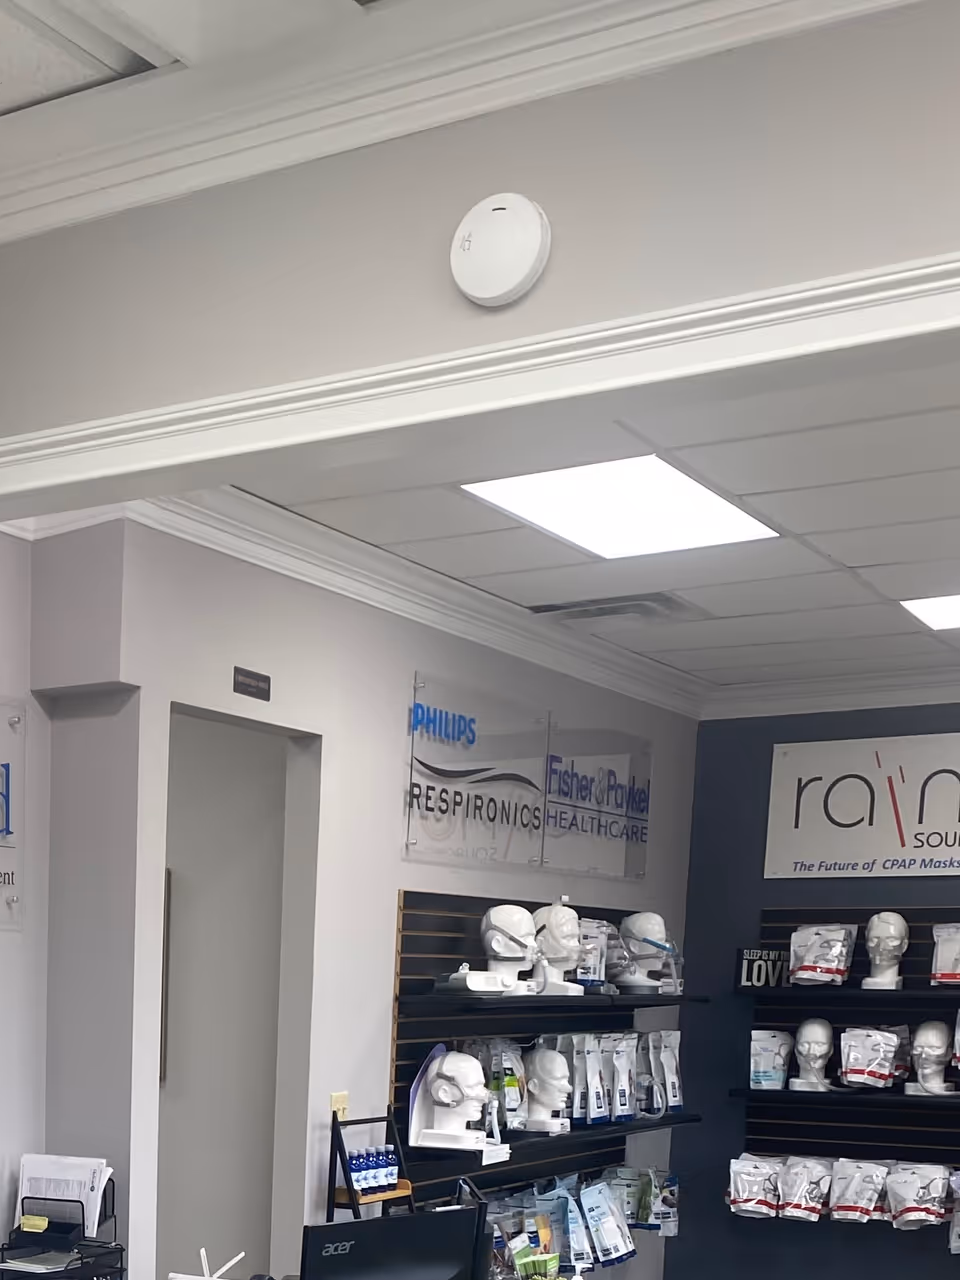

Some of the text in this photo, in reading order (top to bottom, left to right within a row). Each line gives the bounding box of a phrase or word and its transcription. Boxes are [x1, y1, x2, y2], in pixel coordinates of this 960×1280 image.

[412, 702, 476, 745] PHILIPS
[548, 754, 595, 802] Fisher
[607, 769, 650, 816] Paykel
[410, 782, 541, 830] RESPIRONICS
[546, 808, 649, 843] HEALTHCARE
[913, 831, 960, 849] SOU
[792, 857, 960, 873] The Future of CPAP Masks
[743, 949, 761, 960] SLEEP
[762, 950, 769, 960] IS
[322, 1241, 355, 1256] acer
